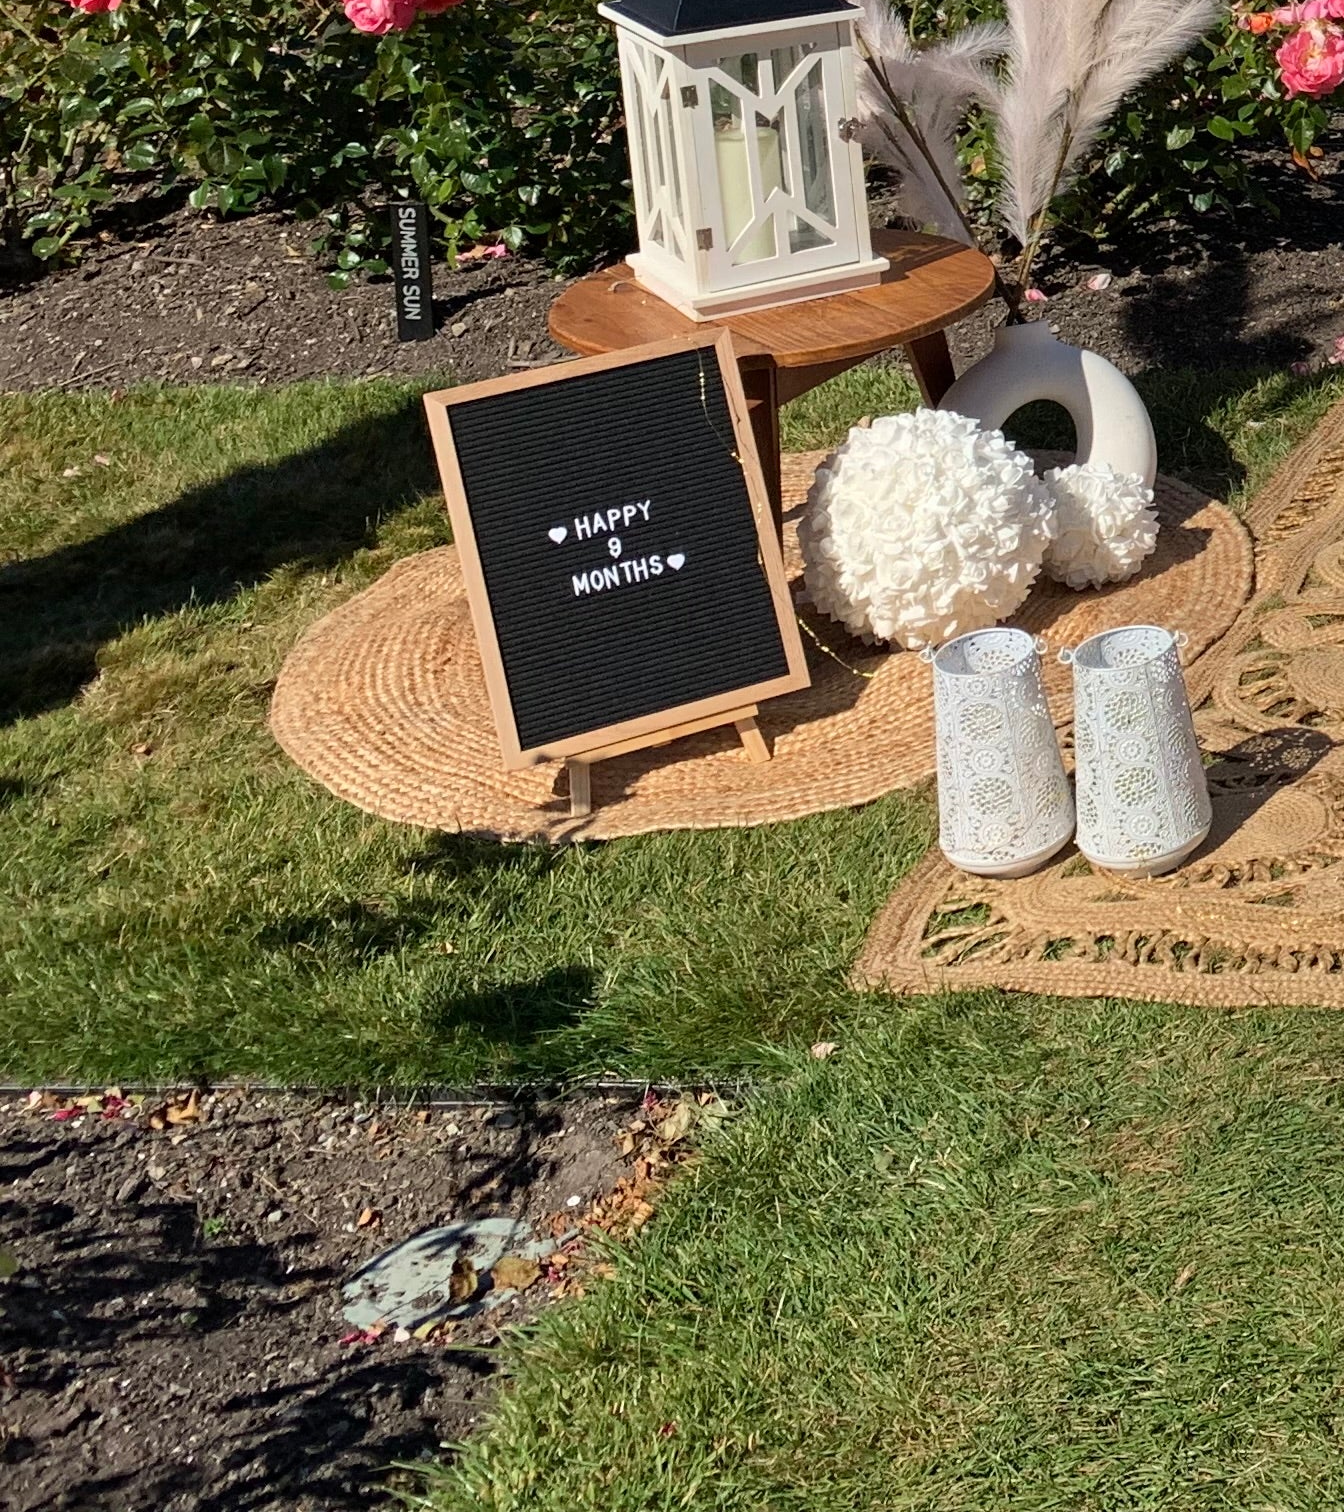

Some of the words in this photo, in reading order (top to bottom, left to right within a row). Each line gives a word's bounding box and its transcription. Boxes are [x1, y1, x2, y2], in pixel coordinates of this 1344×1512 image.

[398, 207, 420, 280] SUMMER
[402, 284, 422, 321] SUN
[574, 499, 651, 541] HAPPY
[607, 536, 622, 559] 9
[572, 554, 664, 597] MONTHS
